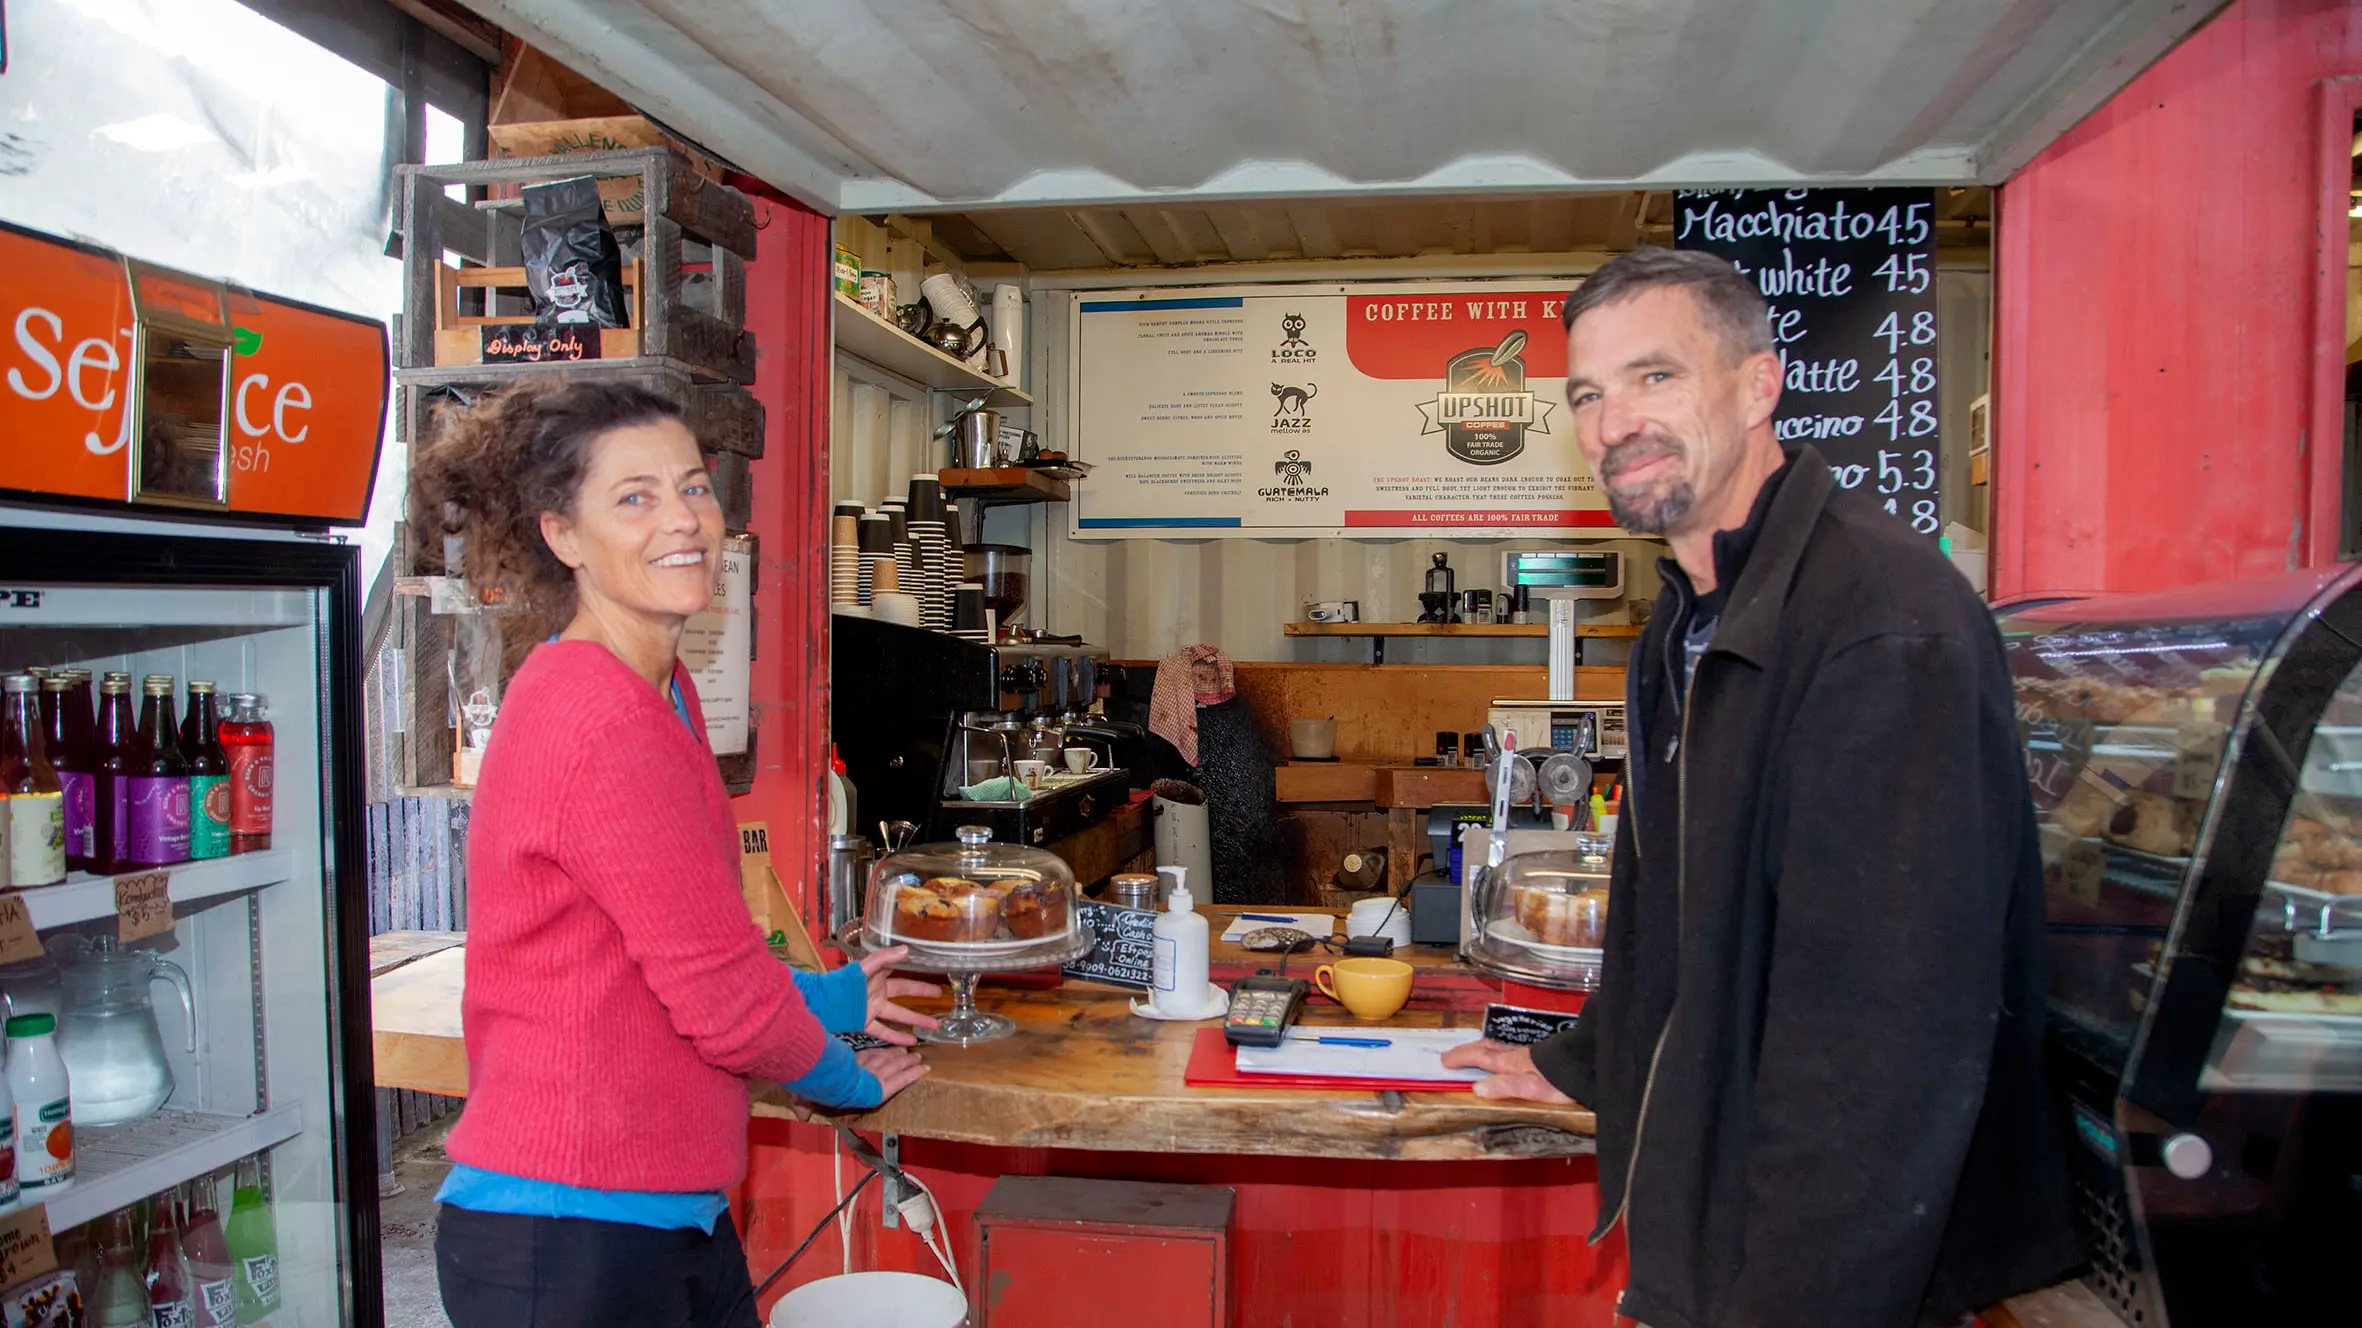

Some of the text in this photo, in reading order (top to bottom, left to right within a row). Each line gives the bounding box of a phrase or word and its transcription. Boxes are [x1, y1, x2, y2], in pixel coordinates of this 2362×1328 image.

[1678, 201, 1875, 243] Macchiato
[1759, 248, 1852, 297] white
[1365, 303, 1453, 322] COFFEE
[1467, 301, 1527, 320] WITH
[487, 335, 583, 360] Display Only
[1271, 350, 1317, 358] LOCO
[1444, 397, 1527, 417] UPSHOT
[1270, 418, 1311, 428] JAZZ
[1465, 421, 1506, 429] COFFEE
[1258, 487, 1329, 496] GUATEMALA
[1487, 513, 1508, 521] 100%
[1511, 513, 1530, 521] FAIR
[1532, 513, 1559, 521] TRADE
[743, 829, 768, 854] BAR
[1122, 928, 1145, 939] Cash
[1119, 954, 1149, 967] Online
